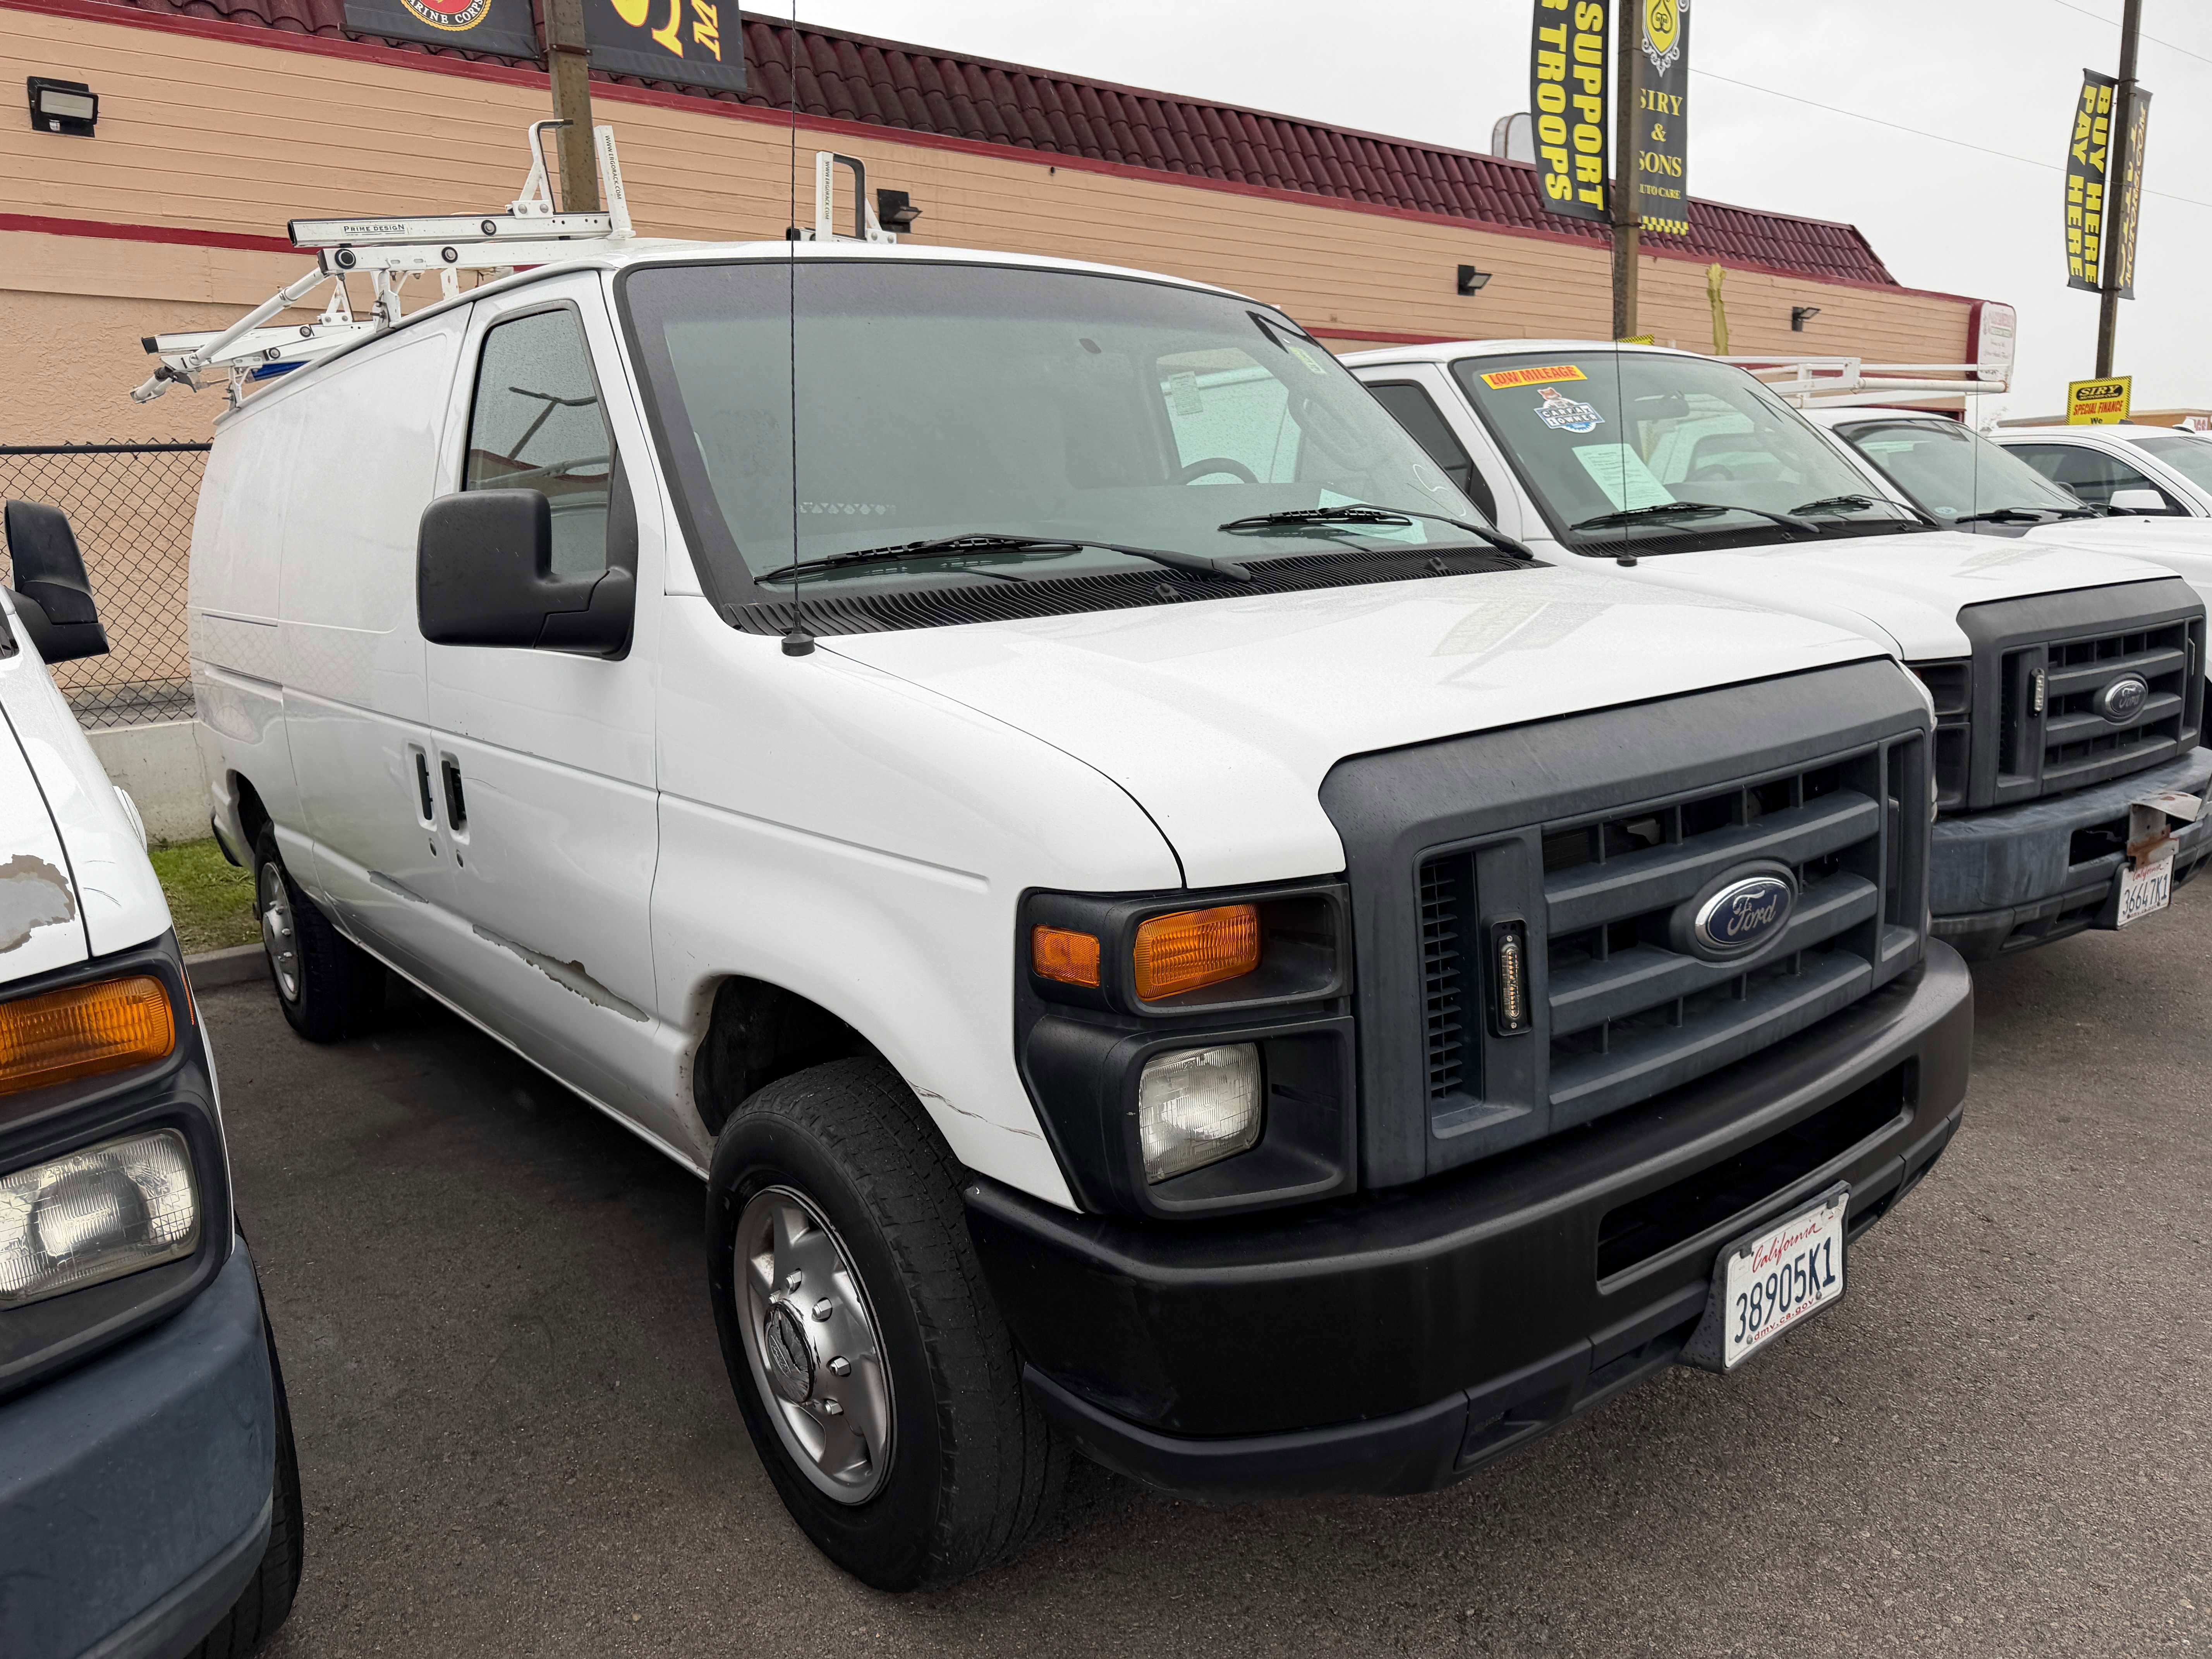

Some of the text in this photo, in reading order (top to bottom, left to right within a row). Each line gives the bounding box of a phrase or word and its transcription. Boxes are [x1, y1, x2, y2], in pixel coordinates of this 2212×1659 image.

[1537, 23, 1572, 201] TROOPS
[1573, 2, 1604, 211] SUPPORT
[1651, 123, 1667, 142] &
[1638, 184, 1658, 196] UTO
[2067, 85, 2097, 277] PAY HERE
[2085, 85, 2112, 283] BUY HERE
[1488, 366, 1580, 386] LOW MILEAGE
[2079, 385, 2121, 396] SIRY
[1541, 405, 1593, 417] CARFAX
[2073, 400, 2123, 416] SPECIAL FINANCE
[2119, 687, 2141, 709] Ford
[2133, 864, 2164, 881] California
[1727, 890, 1778, 936] Ford
[2123, 874, 2168, 915] 36647K1
[1752, 1221, 1823, 1273] California
[1734, 1237, 1836, 1343] 38905K1
[1754, 1298, 1814, 1341] dmv.ca.gov
